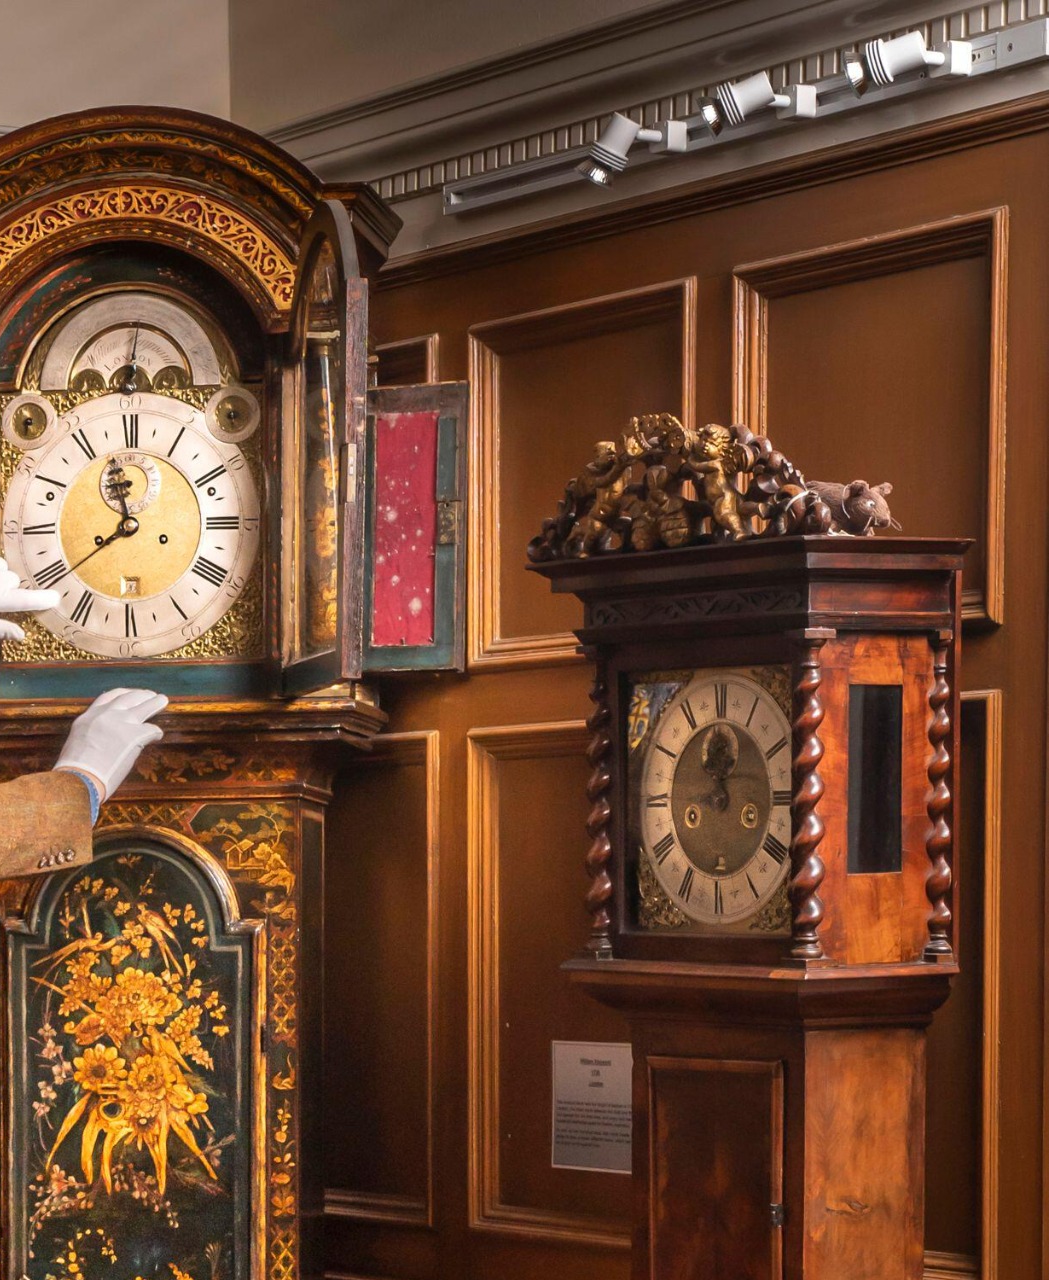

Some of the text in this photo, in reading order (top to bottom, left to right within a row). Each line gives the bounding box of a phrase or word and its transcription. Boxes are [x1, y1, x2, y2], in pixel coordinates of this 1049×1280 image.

[104, 353, 151, 371] LONON
[120, 396, 142, 410] 60
[62, 411, 80, 432] 55
[187, 410, 198, 424] 5
[121, 414, 139, 448] XII
[167, 426, 185, 458] I
[17, 456, 36, 477] 50
[227, 453, 245, 471] 10
[194, 464, 227, 488] II
[4, 519, 19, 540] 45
[206, 516, 239, 530] III
[244, 517, 259, 531] 15
[191, 556, 228, 588] IIII
[226, 576, 244, 598] 20
[181, 621, 201, 642] 25
[119, 641, 142, 658] 30
[745, 696, 760, 728] I
[765, 736, 789, 761] II
